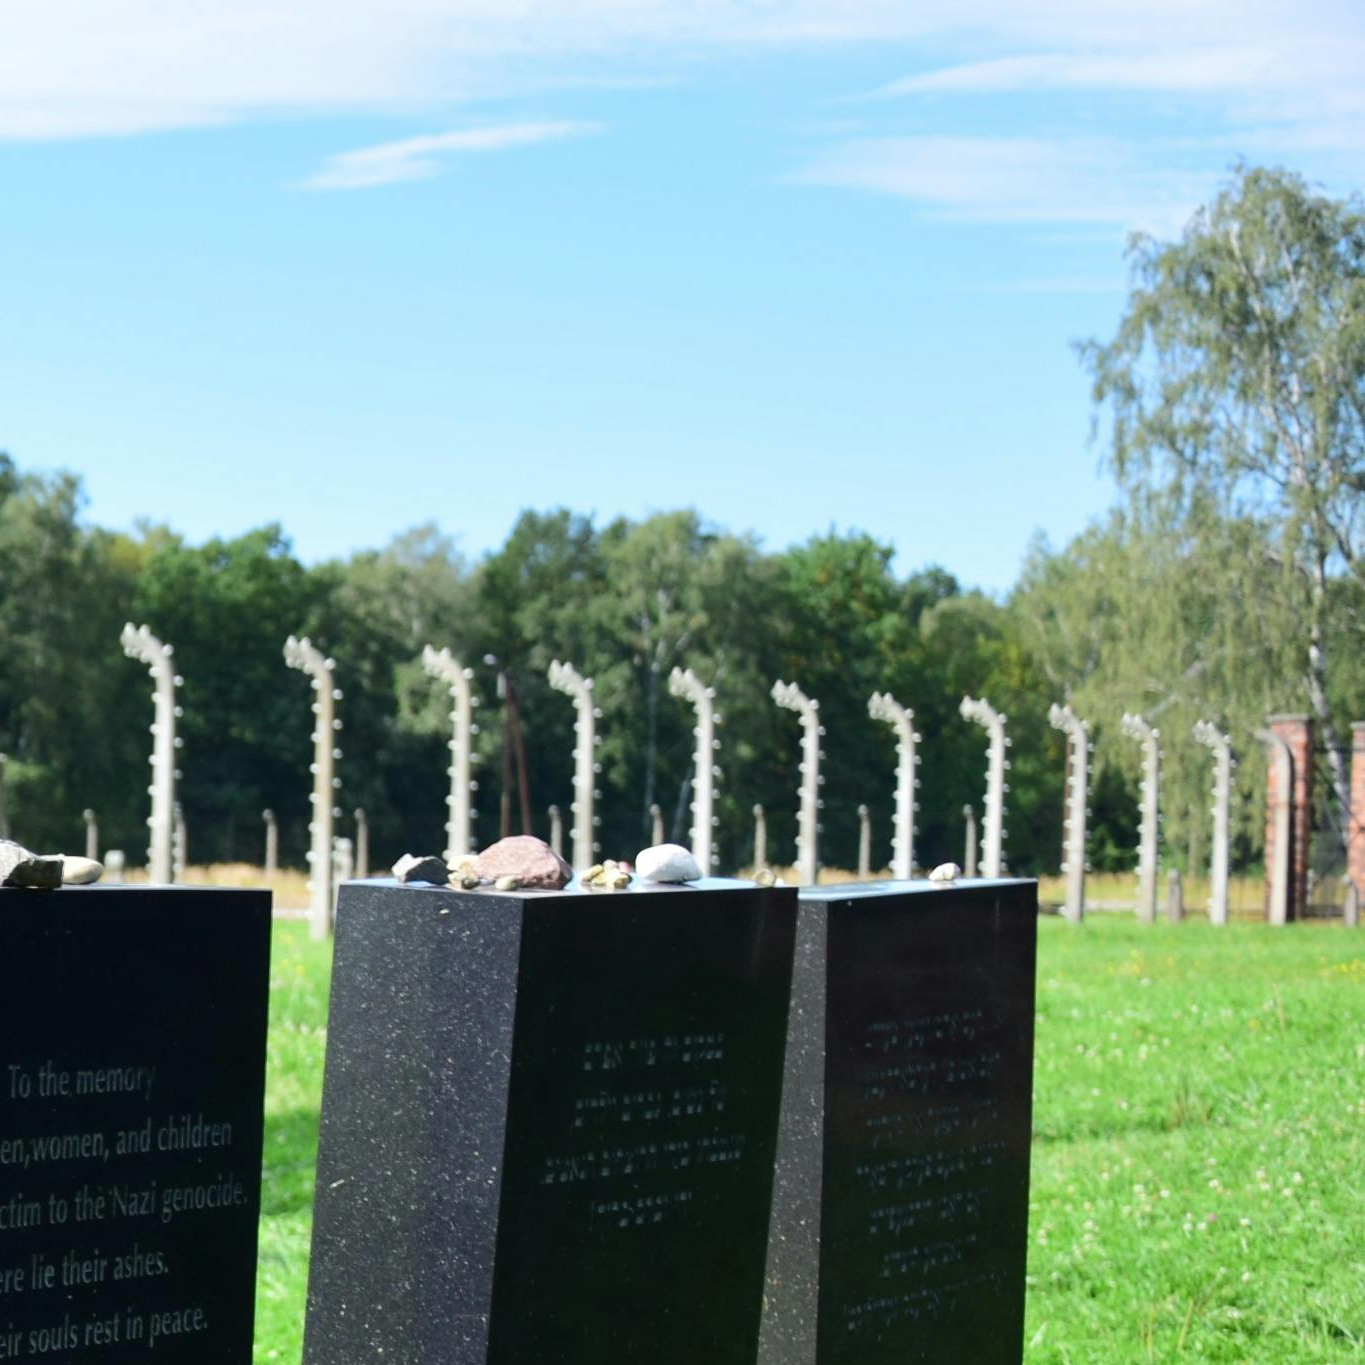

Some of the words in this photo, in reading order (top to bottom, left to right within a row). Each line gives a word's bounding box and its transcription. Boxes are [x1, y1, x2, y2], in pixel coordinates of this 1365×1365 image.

[8, 1064, 31, 1099] To
[39, 1060, 70, 1097] the
[76, 1064, 156, 1100] memory
[117, 1117, 151, 1155] and
[158, 1113, 232, 1151] children
[49, 1192, 68, 1224] to
[74, 1186, 103, 1220] the
[110, 1181, 156, 1218] Nazi
[32, 1254, 55, 1289] lie
[62, 1249, 108, 1286] their
[113, 1243, 169, 1280] ashes.
[29, 1314, 78, 1354] souls
[85, 1315, 120, 1345] rest
[127, 1307, 143, 1340] in
[150, 1306, 208, 1347] peace.
